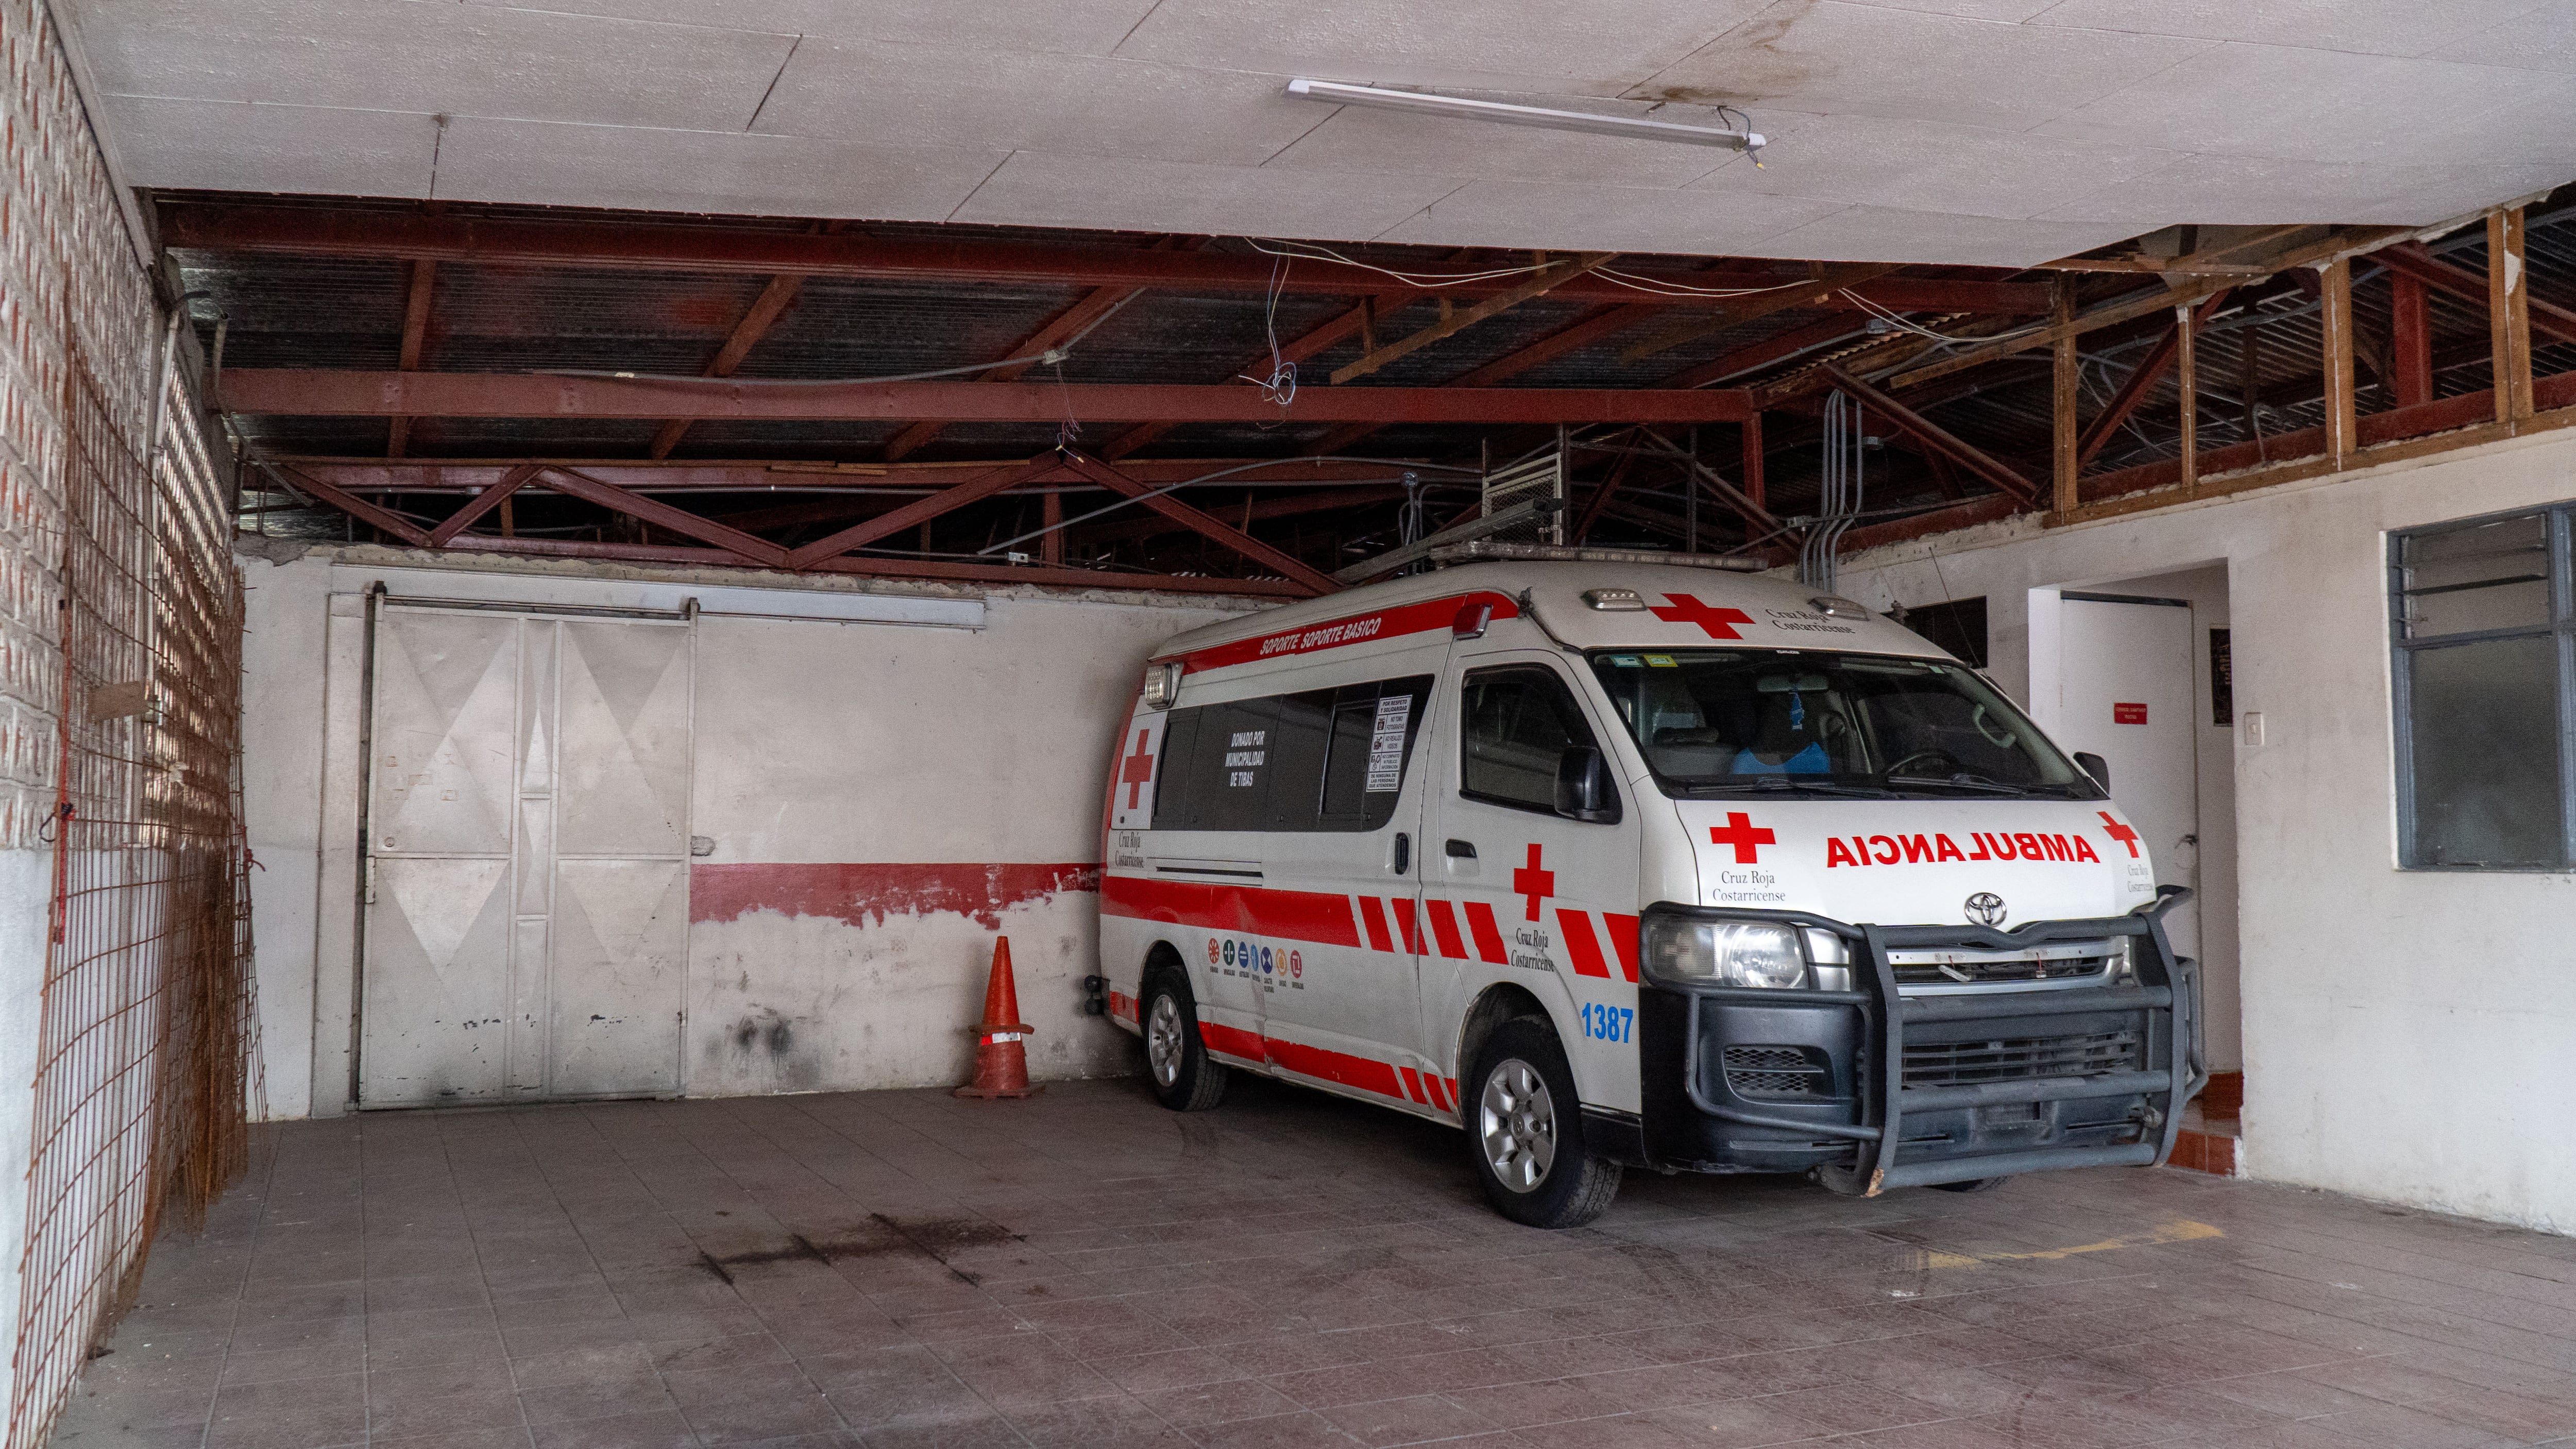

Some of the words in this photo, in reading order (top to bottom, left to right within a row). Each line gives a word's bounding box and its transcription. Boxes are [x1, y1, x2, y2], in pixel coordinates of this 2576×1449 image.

[1765, 609, 1800, 619] Cruz
[1797, 611, 1830, 623] Roja
[1772, 620, 1856, 634] Costarricense
[1260, 633, 1301, 655] SOPORTE
[1300, 625, 1345, 649] SOPORTE
[1342, 617, 1382, 641] BASICO
[1231, 731, 1253, 747] DONADO
[1252, 731, 1265, 746] POR
[1225, 751, 1264, 766] MUNICIPALIDAD
[1230, 772, 1238, 787] DE
[1238, 771, 1253, 787] TIBAS
[1119, 831, 1129, 847] Cruz
[1130, 831, 1140, 853] Roja
[1115, 850, 1144, 868] Costarricense
[1721, 871, 1748, 884] Cruz
[1751, 871, 1775, 888] Roja
[1713, 888, 1786, 901] Costarricense
[1516, 928, 1532, 946] Cruz
[1533, 930, 1548, 953] Roja
[1511, 949, 1555, 973] Costarricense
[1582, 1002, 1633, 1043] 1387
